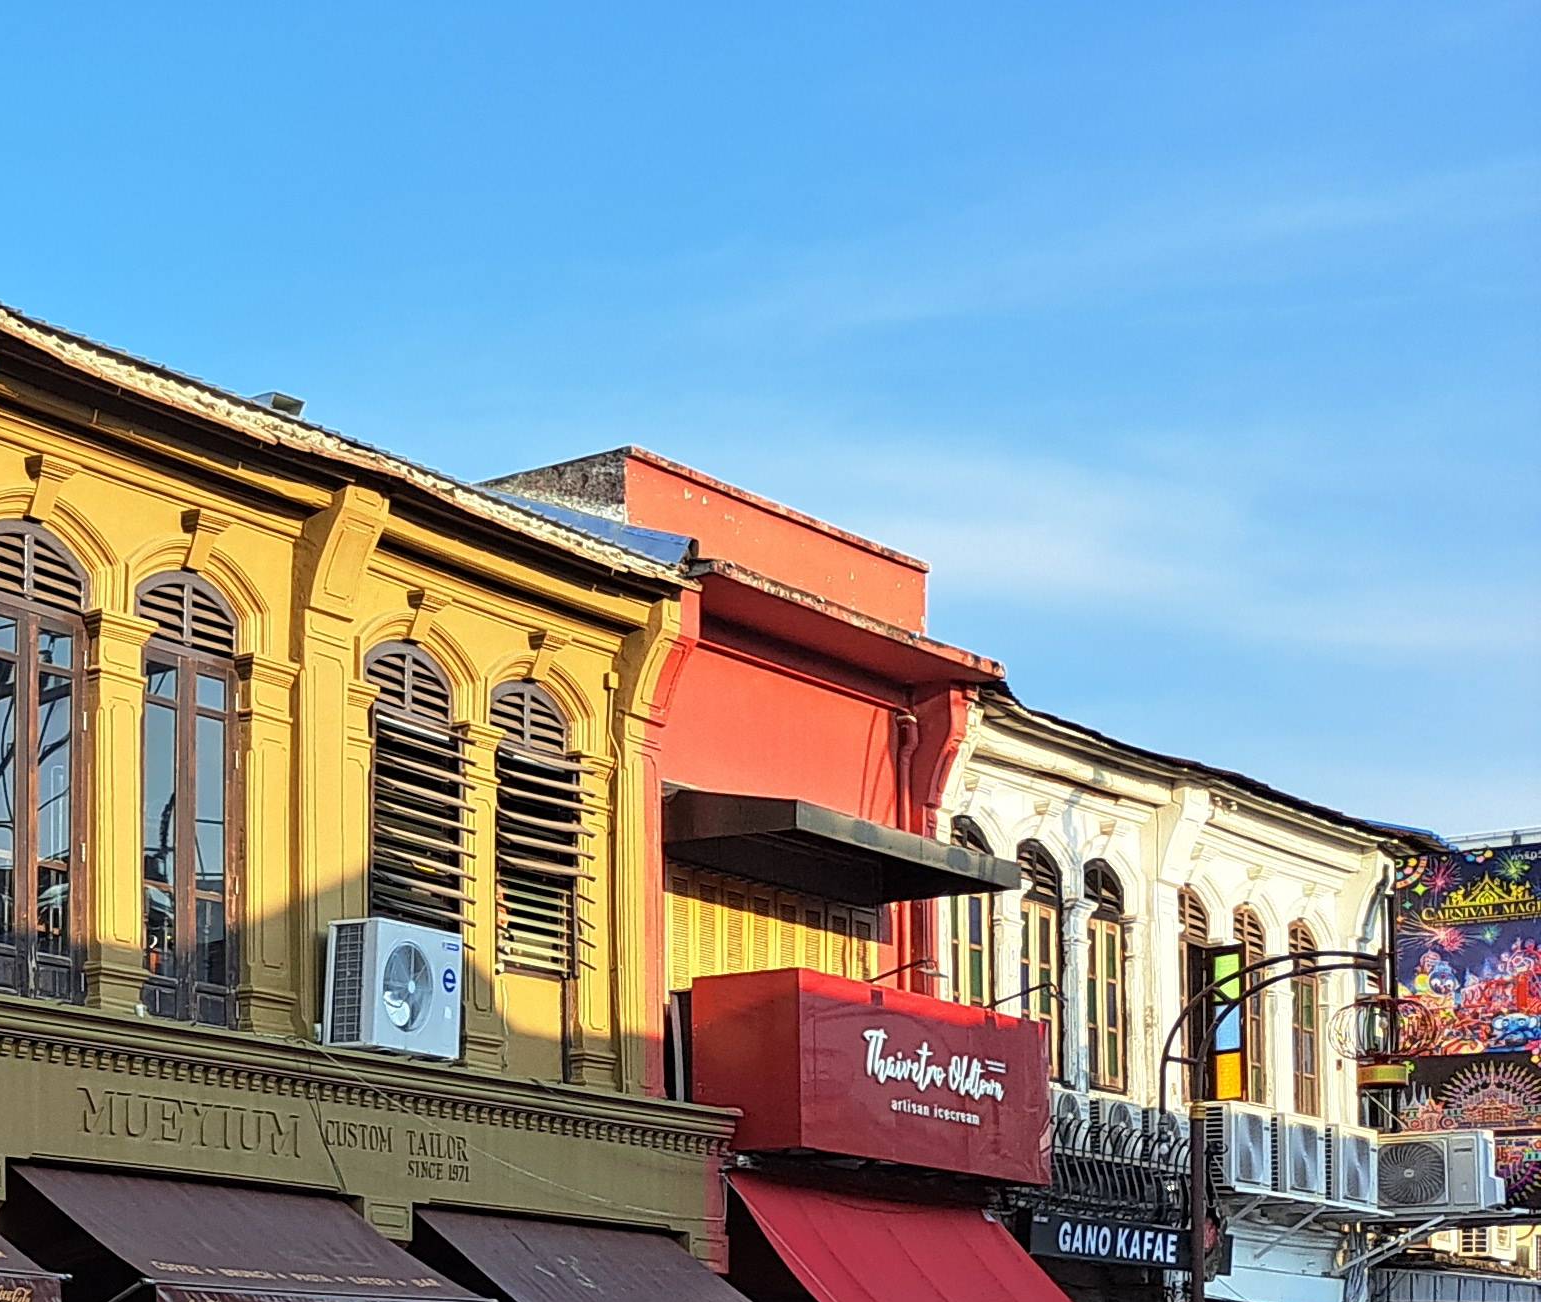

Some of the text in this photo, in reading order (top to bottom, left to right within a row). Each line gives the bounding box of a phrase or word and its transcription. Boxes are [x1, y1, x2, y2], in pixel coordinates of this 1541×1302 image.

[1421, 905, 1497, 921] CARNIVAL
[948, 1055, 1004, 1101] Oldtown
[77, 1087, 300, 1158] MUEYIUM
[891, 1099, 981, 1126] artisan icecream
[325, 1120, 469, 1162] CUSTOM TAILOR
[407, 1160, 470, 1182] SINCE 1971
[1058, 1221, 1178, 1264] GANO KAFAE
